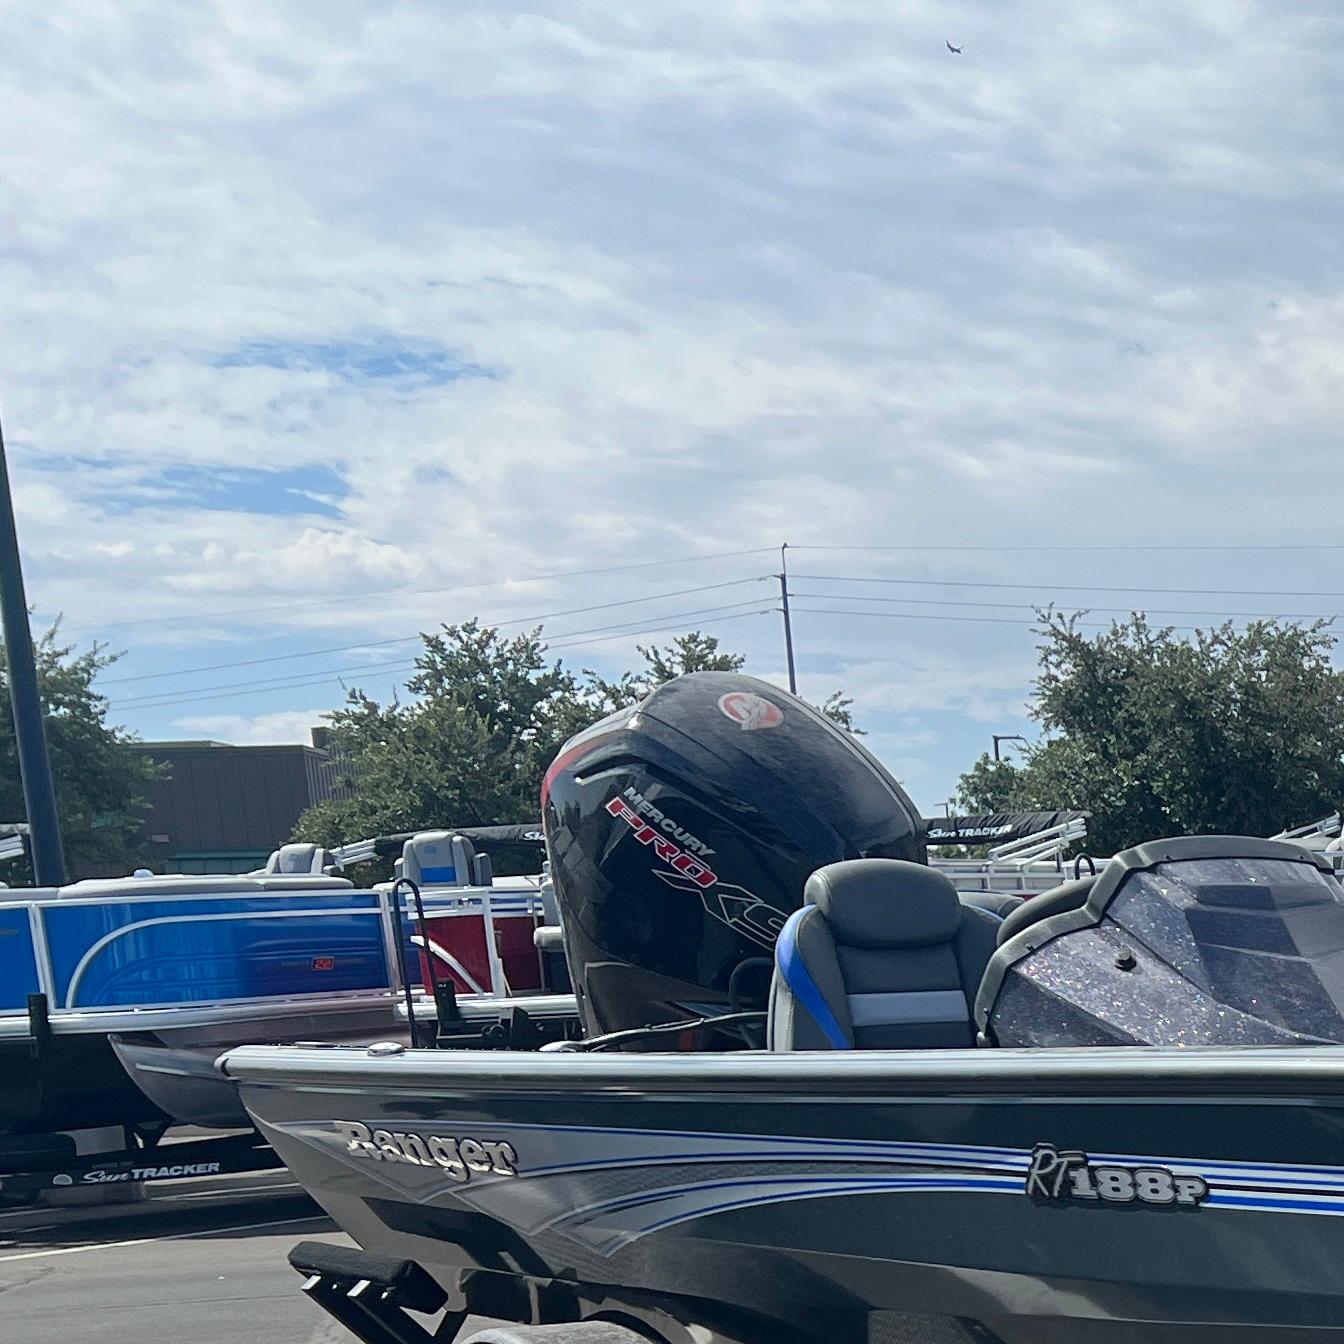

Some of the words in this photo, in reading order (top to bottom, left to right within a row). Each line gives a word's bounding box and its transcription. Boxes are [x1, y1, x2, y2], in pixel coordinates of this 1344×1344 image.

[606, 796, 718, 888] PRO
[623, 786, 716, 856] MERCURY
[958, 824, 1013, 838] TRACKER
[83, 1167, 130, 1185] Sun
[131, 1162, 220, 1180] TRACKER
[334, 1120, 520, 1184] Ranger
